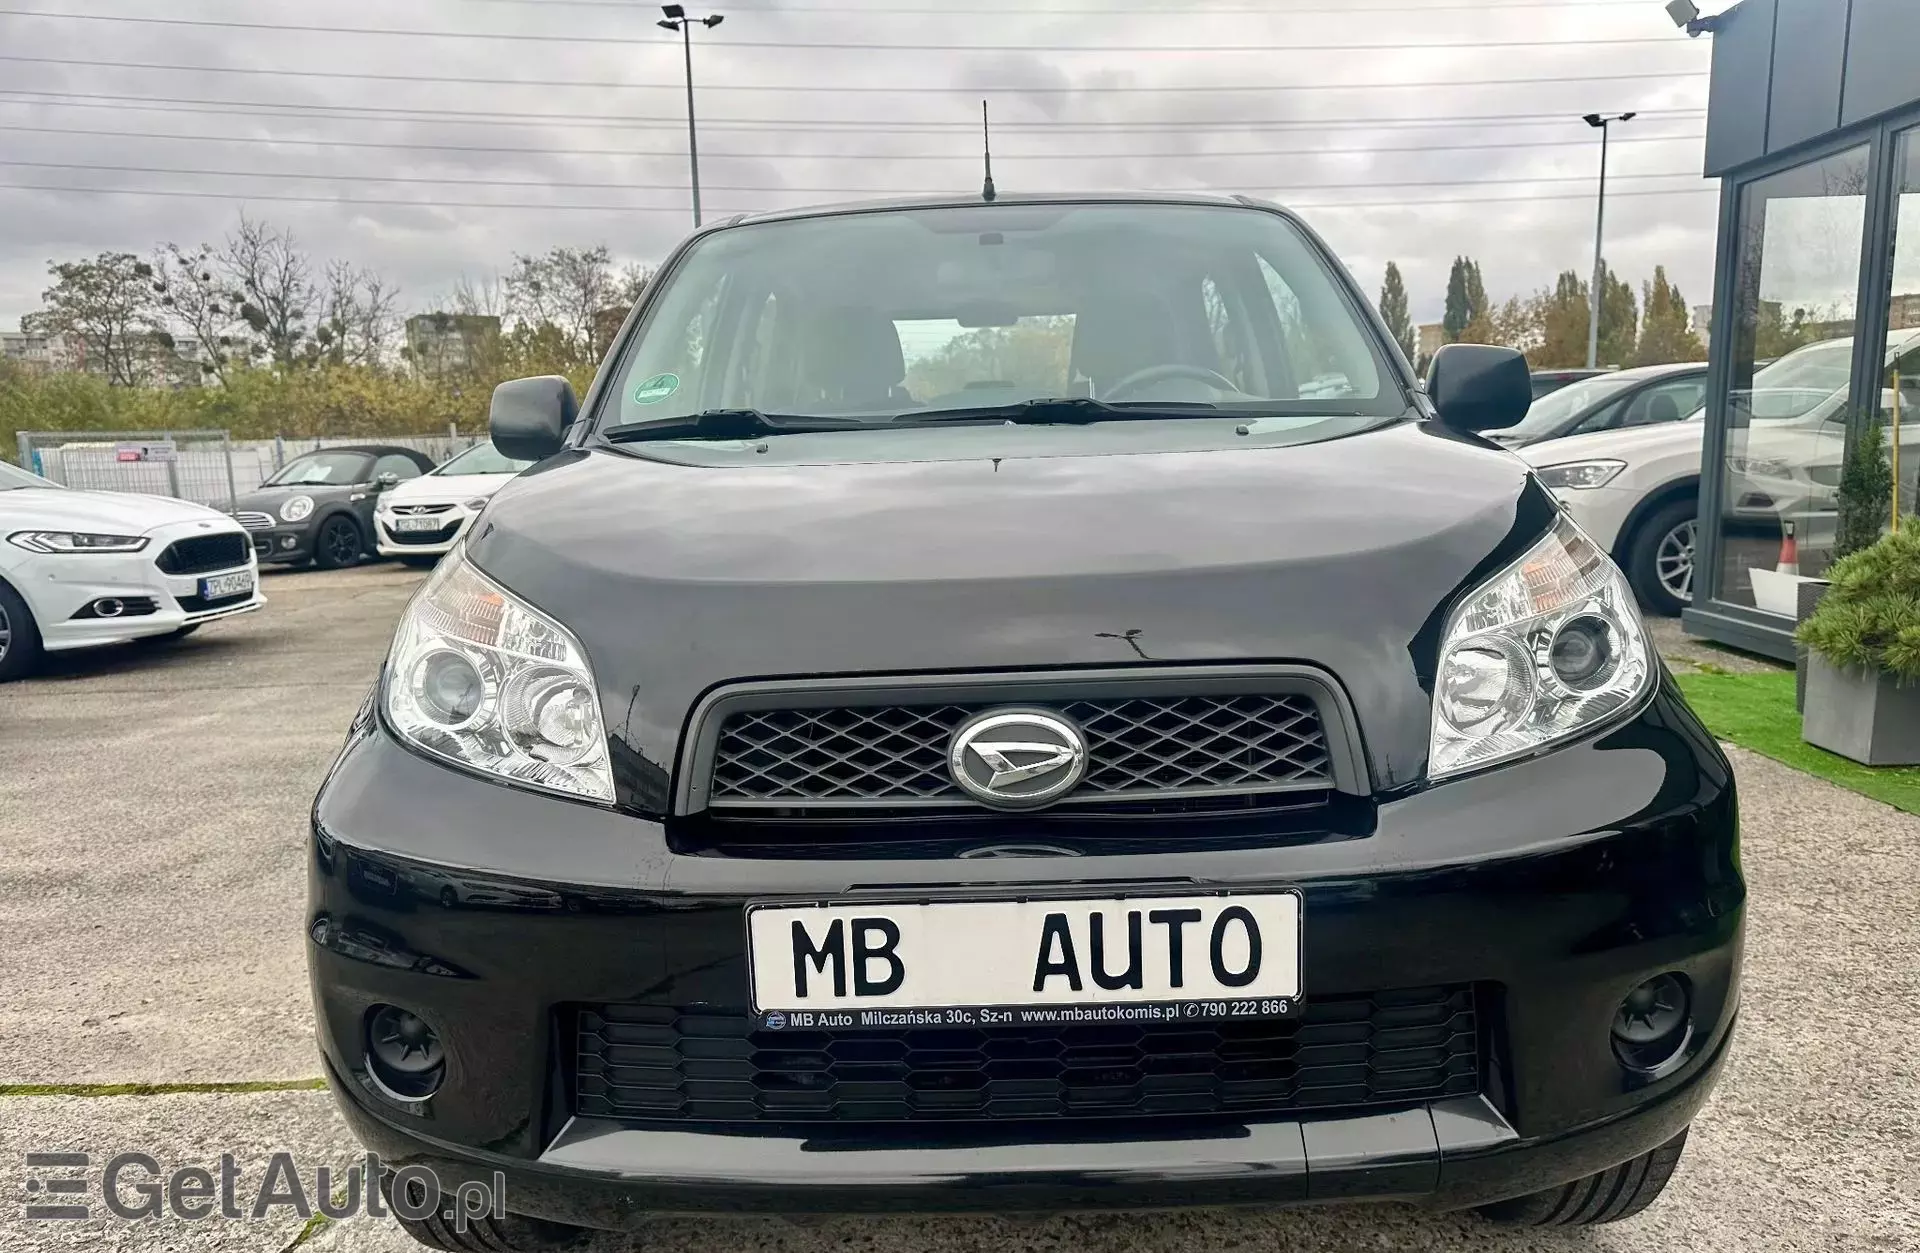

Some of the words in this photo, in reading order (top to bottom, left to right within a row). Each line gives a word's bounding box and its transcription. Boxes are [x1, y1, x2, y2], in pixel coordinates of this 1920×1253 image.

[791, 917, 905, 997] MB
[1033, 905, 1262, 992] AUTO
[790, 1012, 813, 1027] MB
[818, 1012, 853, 1026] Auto
[861, 1010, 942, 1026] Milczańska
[946, 1009, 976, 1025] 30c,
[980, 1008, 1013, 1023] Sz-n
[1021, 1003, 1179, 1021] www.mbautokomis.pl
[1201, 1002, 1227, 1017] 790
[1231, 1001, 1257, 1016] 222
[1261, 1000, 1288, 1014] 866
